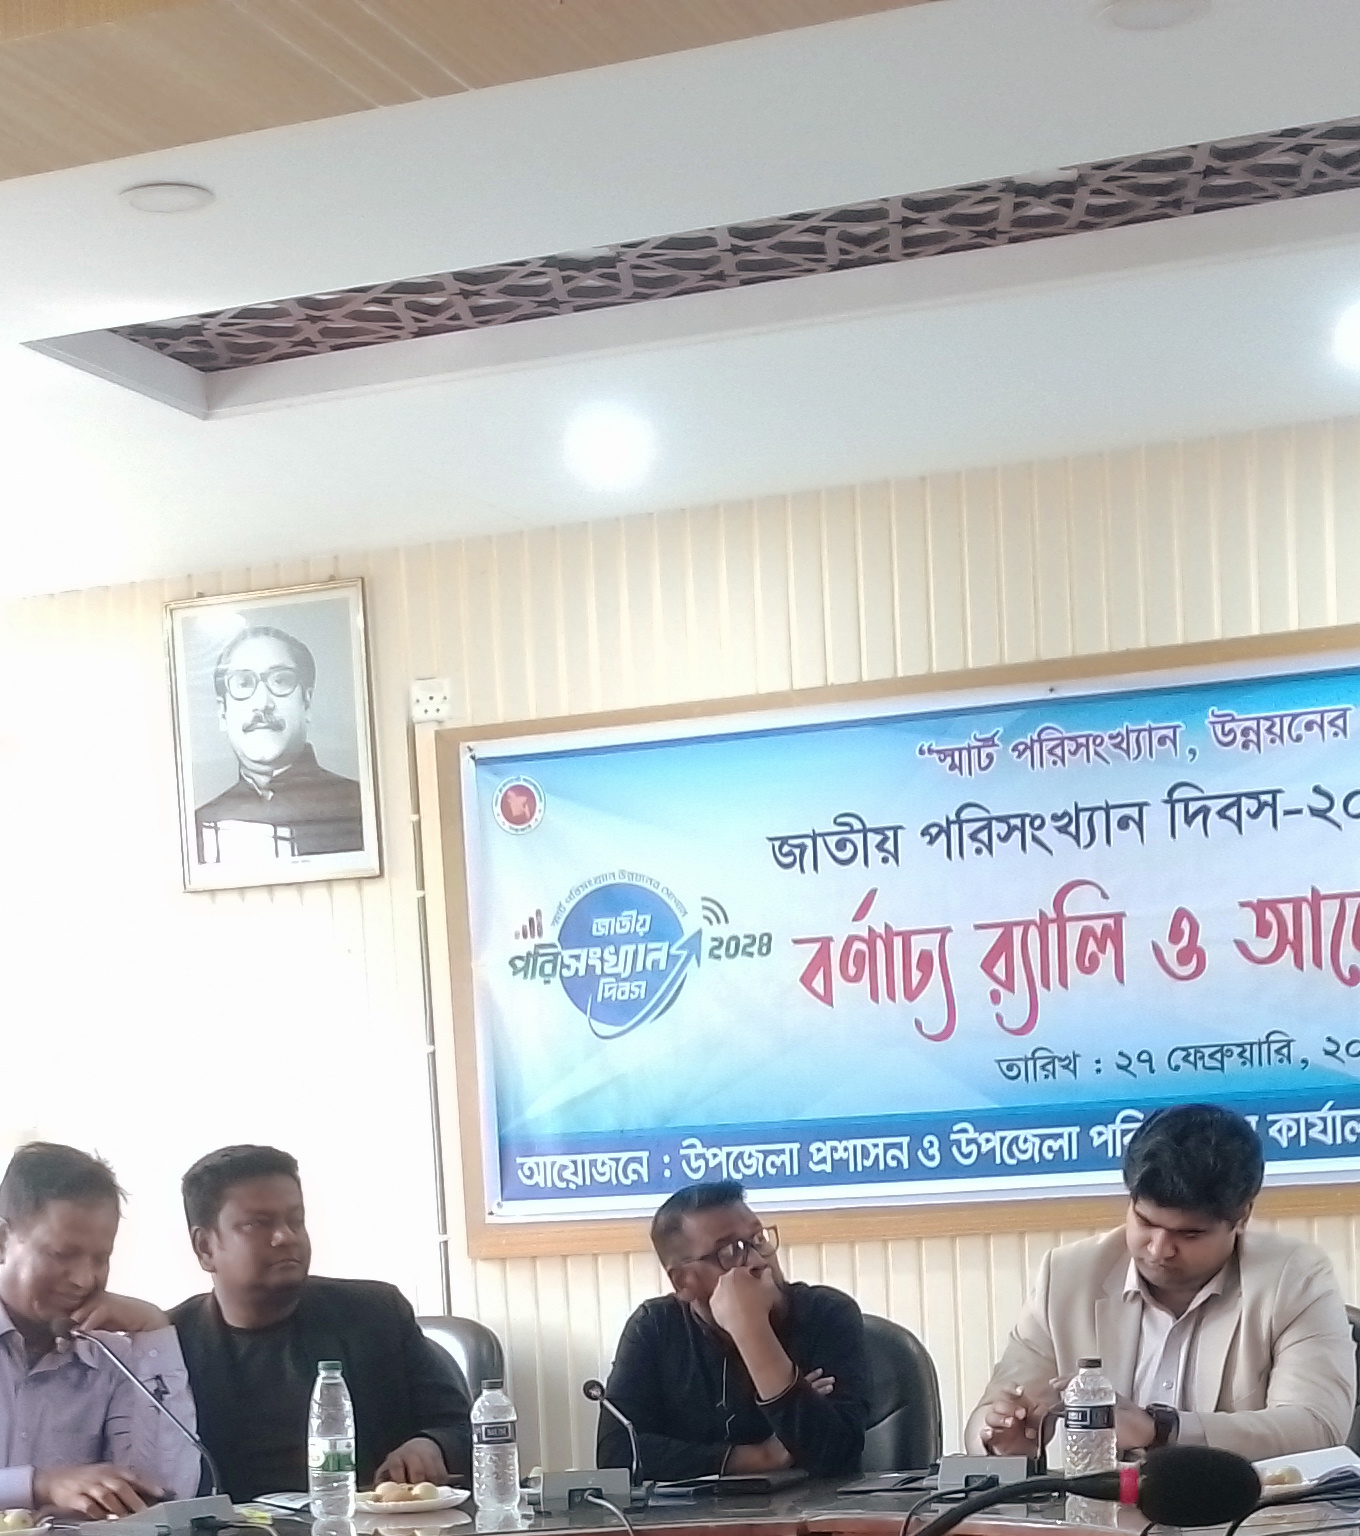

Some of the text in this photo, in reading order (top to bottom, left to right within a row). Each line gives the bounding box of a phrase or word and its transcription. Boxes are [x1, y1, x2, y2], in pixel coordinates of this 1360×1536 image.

[1209, 707, 1353, 753] উন্নয়নের
[766, 813, 906, 874] জাতীয়
[920, 802, 1151, 862] পরিসংখ্যান
[591, 908, 652, 938] জাতীয়
[508, 941, 671, 984] পরিসংখ্যান
[791, 887, 958, 1042] বর্ণাঢ্য
[1151, 906, 1208, 982] ও
[597, 977, 647, 1004] দিবস
[994, 1047, 1081, 1083] তারিখ
[1115, 1049, 1156, 1078] ২৭
[515, 1150, 650, 1190] আয়োজনে
[679, 1137, 800, 1180] উপজেলা
[808, 1136, 911, 1173] প্রশাসন
[916, 1134, 942, 1169] ও
[949, 1121, 1081, 1166] উপজেলা
